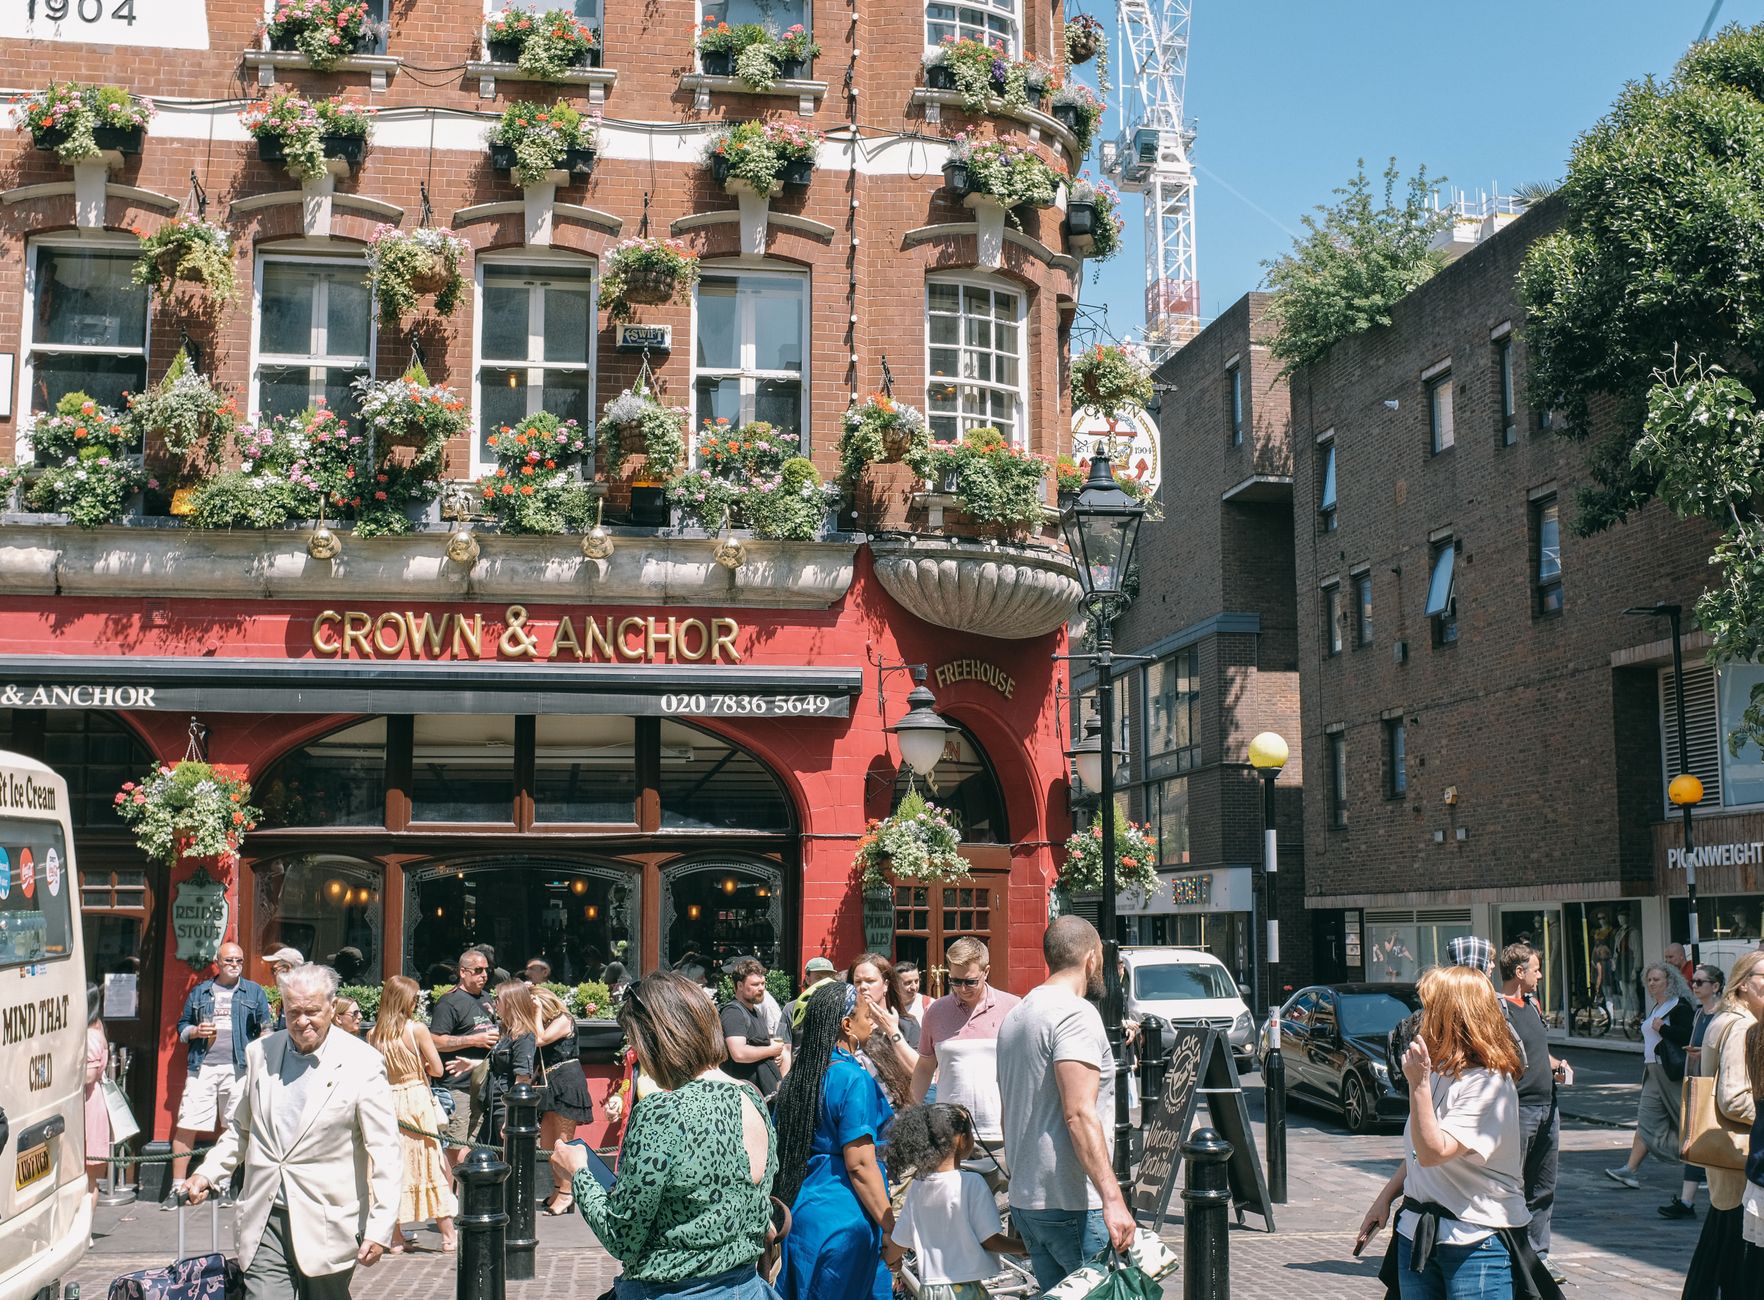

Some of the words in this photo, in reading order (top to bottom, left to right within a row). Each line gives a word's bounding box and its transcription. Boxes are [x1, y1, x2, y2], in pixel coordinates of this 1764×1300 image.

[630, 328, 664, 342] SWIFT
[312, 610, 482, 657] CROWN
[500, 605, 538, 657] &
[551, 615, 741, 660] ANCHOR
[1, 685, 24, 706] &
[27, 685, 155, 707] ANCHOR
[935, 659, 1016, 699] FREEHOUSE
[661, 693, 706, 713] 020
[710, 694, 767, 714] 7836
[774, 694, 830, 714] 5649
[9, 773, 24, 809] Ice
[27, 776, 56, 811] Cream
[177, 924, 222, 939] STOUT
[2, 1002, 37, 1046] MIND
[38, 994, 69, 1036] THAT
[1144, 1119, 1180, 1159] Vintage
[1139, 1151, 1172, 1189] Clothing
